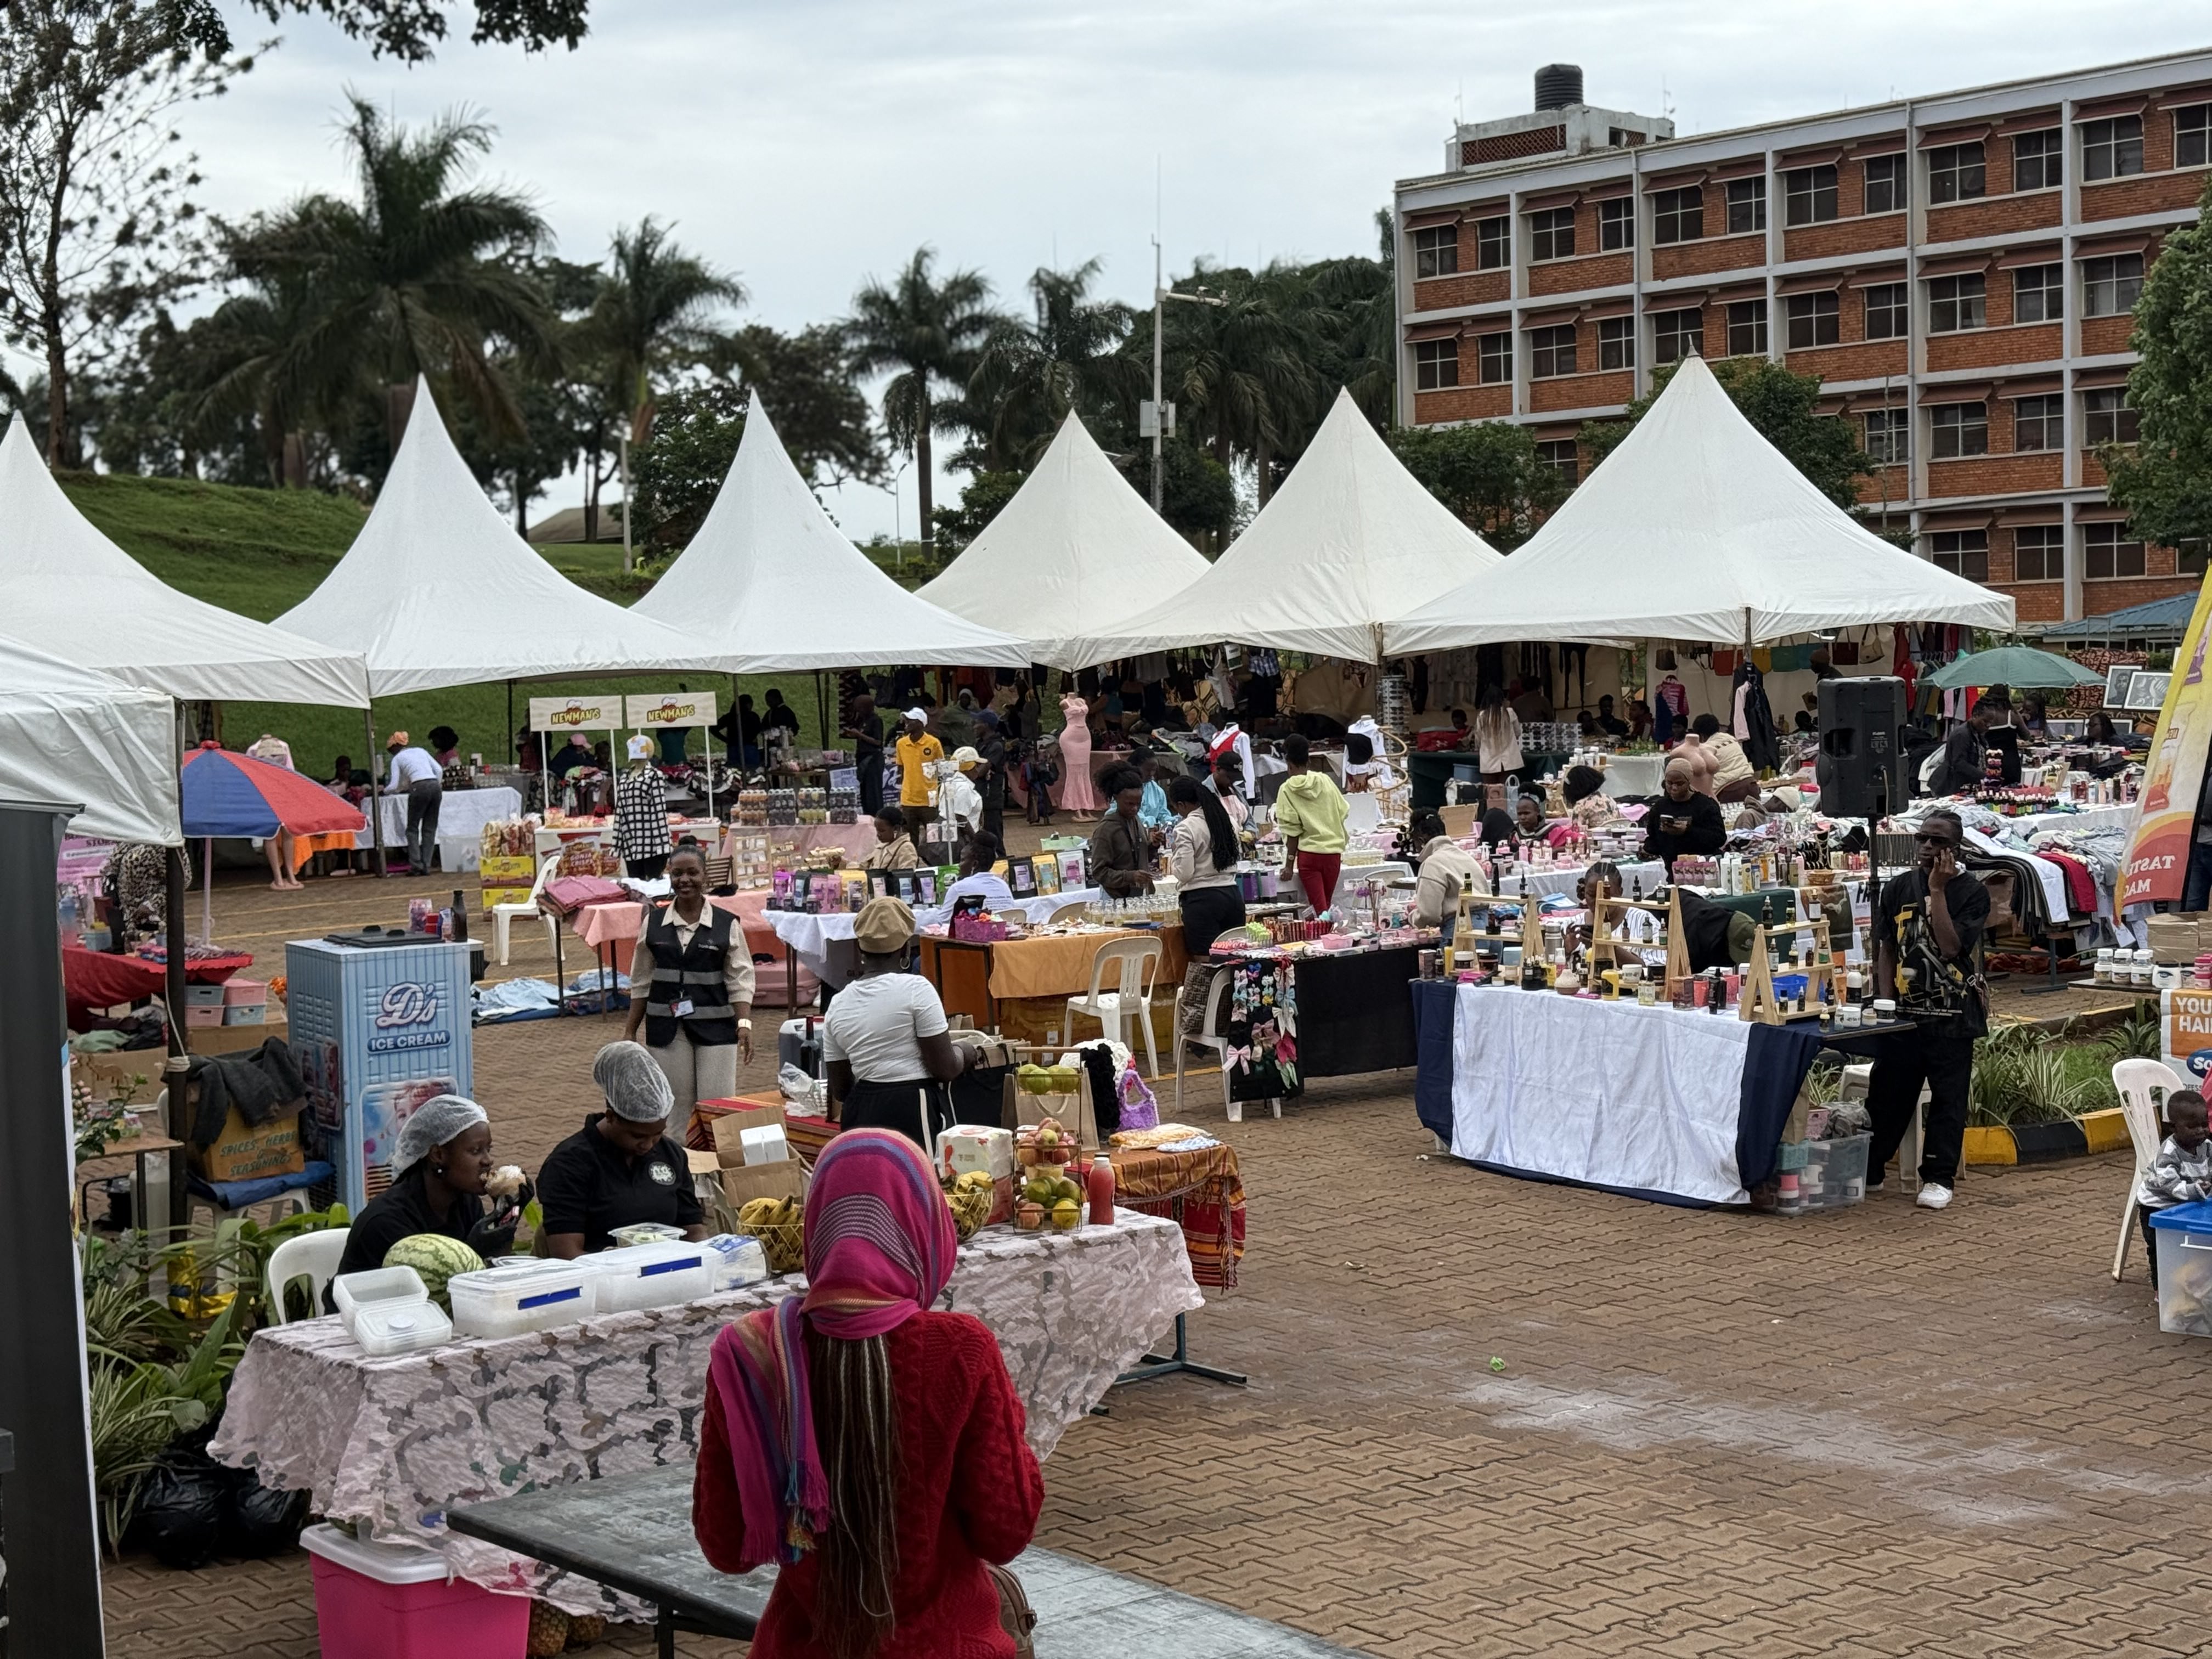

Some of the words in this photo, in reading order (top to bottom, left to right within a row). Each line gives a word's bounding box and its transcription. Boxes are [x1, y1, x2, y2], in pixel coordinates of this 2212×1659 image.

[552, 708, 600, 724] NEWMAN'S
[648, 706, 695, 721] NEWMAN'S
[571, 853, 592, 861] GONJA
[571, 859, 594, 867] CRISPS
[376, 981, 438, 1028] D's
[2179, 1015, 2212, 1034] HAI
[371, 1037, 394, 1050] ICE
[397, 1032, 447, 1047] CREAM
